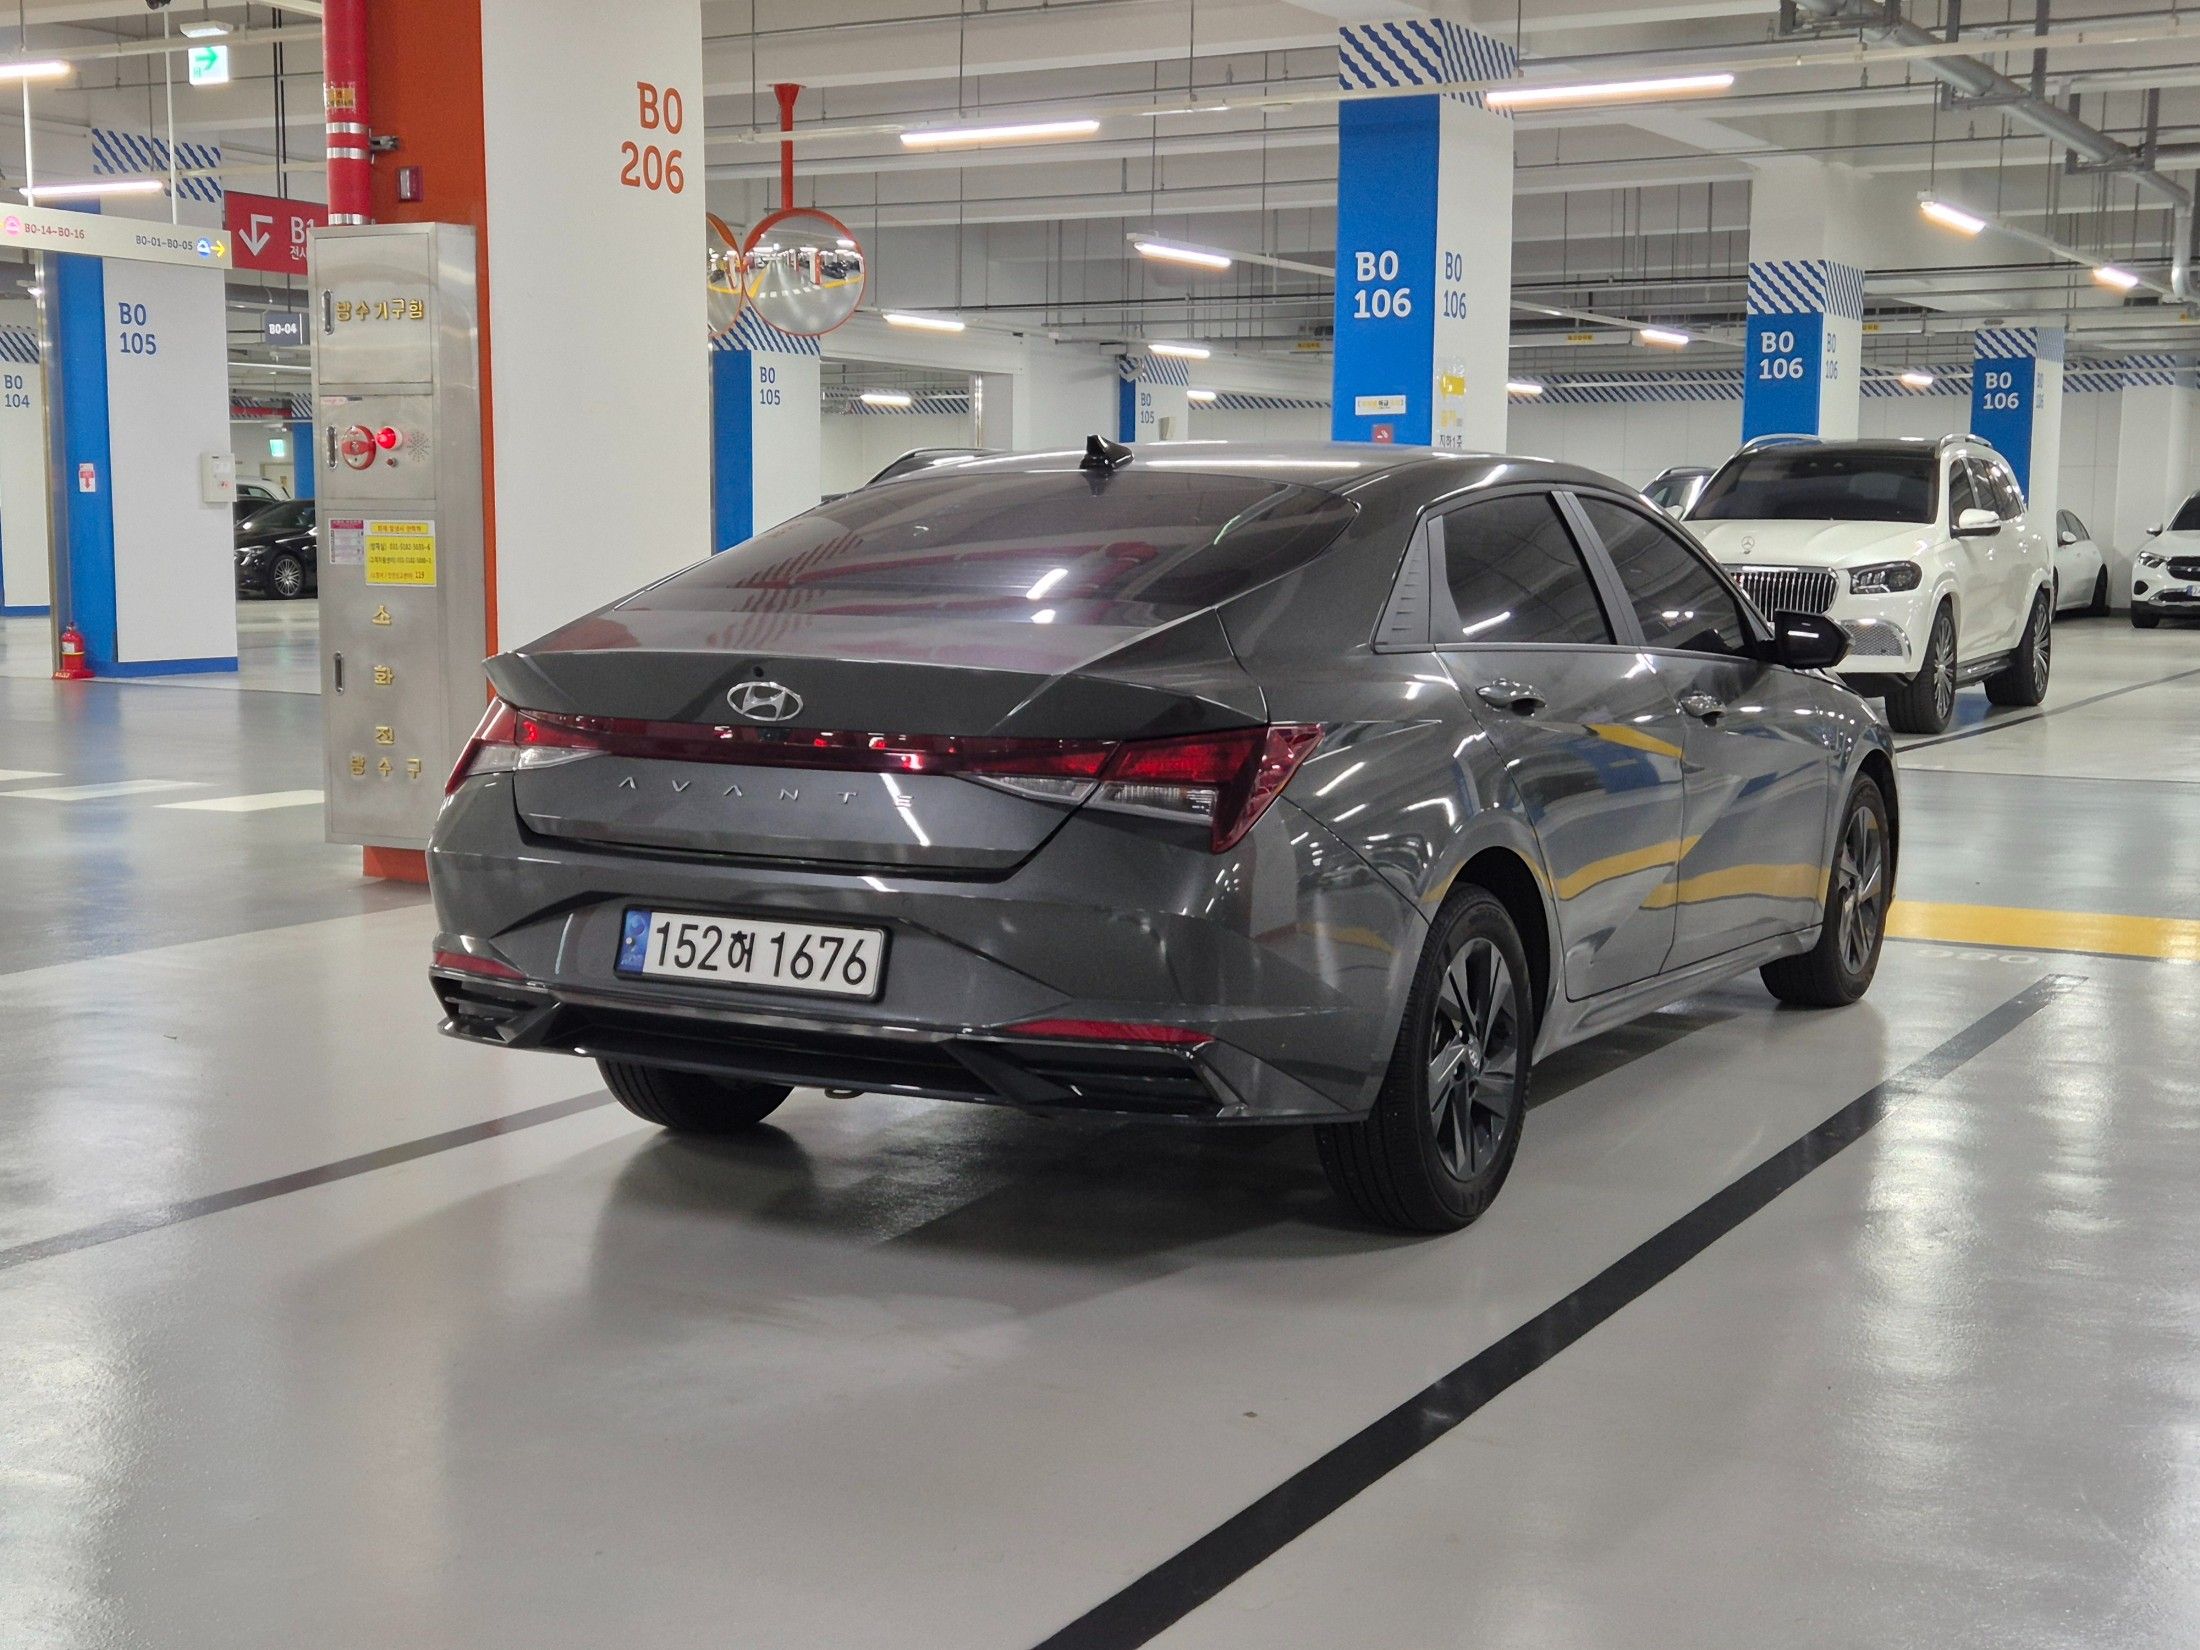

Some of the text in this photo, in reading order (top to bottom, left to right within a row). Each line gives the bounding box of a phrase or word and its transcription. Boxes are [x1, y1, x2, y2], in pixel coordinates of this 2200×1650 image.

[620, 141, 684, 194] 206
[1353, 288, 1412, 319] 106
[1443, 290, 1466, 319] 106
[120, 332, 157, 355] 105
[1759, 358, 1804, 379] 106
[5, 393, 30, 409] 104
[760, 388, 781, 406] 105
[1983, 392, 2020, 410] 106
[1140, 410, 1155, 425] 105
[351, 755, 421, 779] 방수구
[618, 777, 914, 807] AVANTE
[656, 921, 867, 985] 152허 1676
